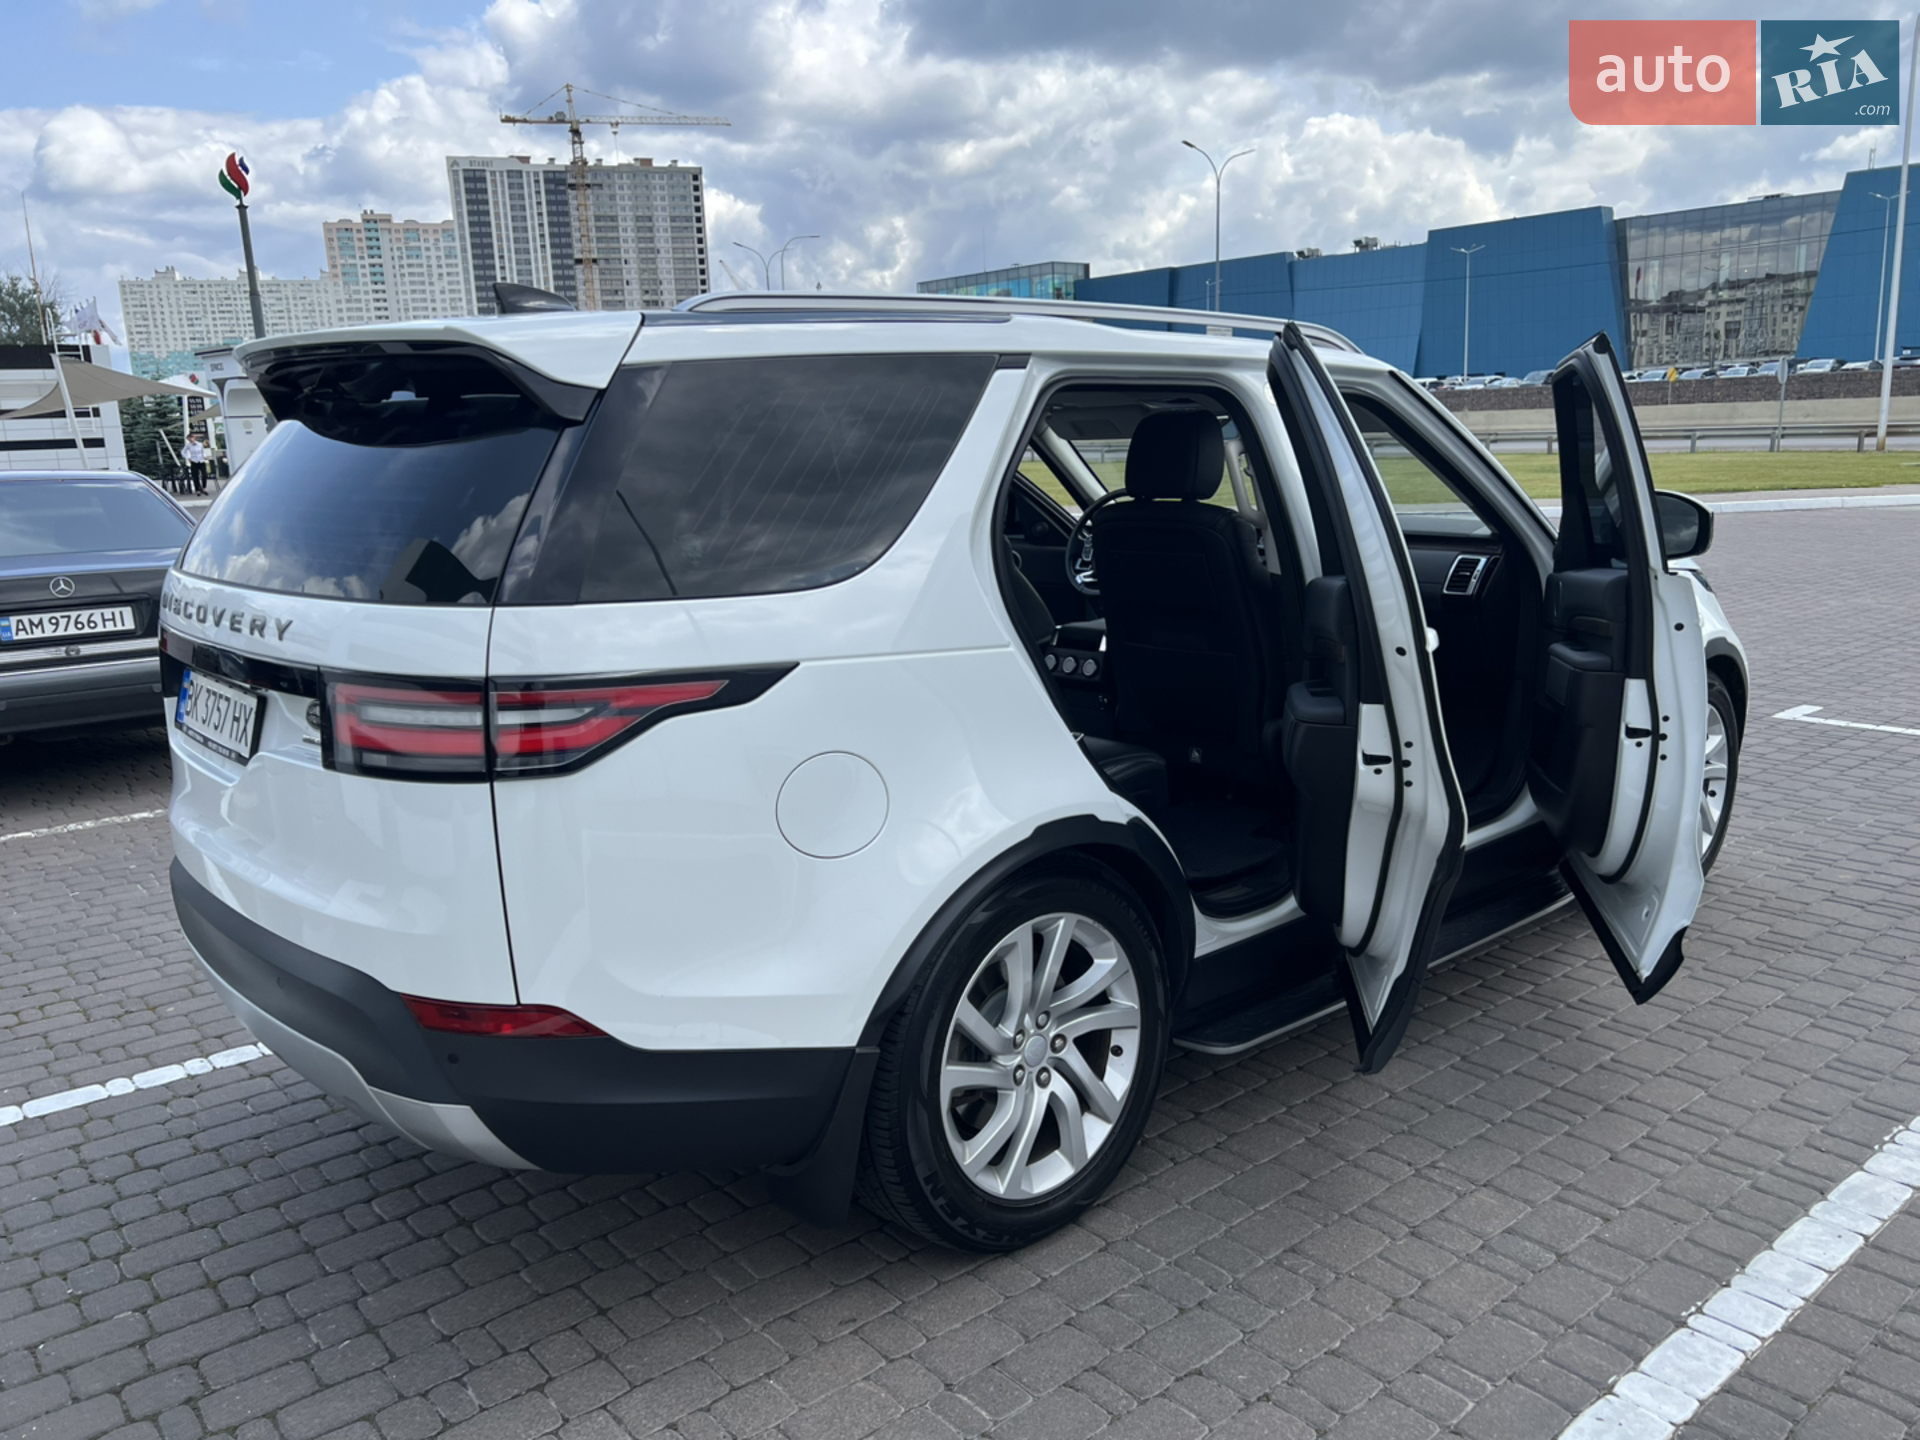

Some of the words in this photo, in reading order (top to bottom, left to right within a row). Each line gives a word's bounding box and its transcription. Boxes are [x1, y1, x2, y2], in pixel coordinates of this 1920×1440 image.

[161, 591, 294, 642] DISCOVERY
[201, 686, 232, 734] 3757
[229, 700, 254, 748] HX
